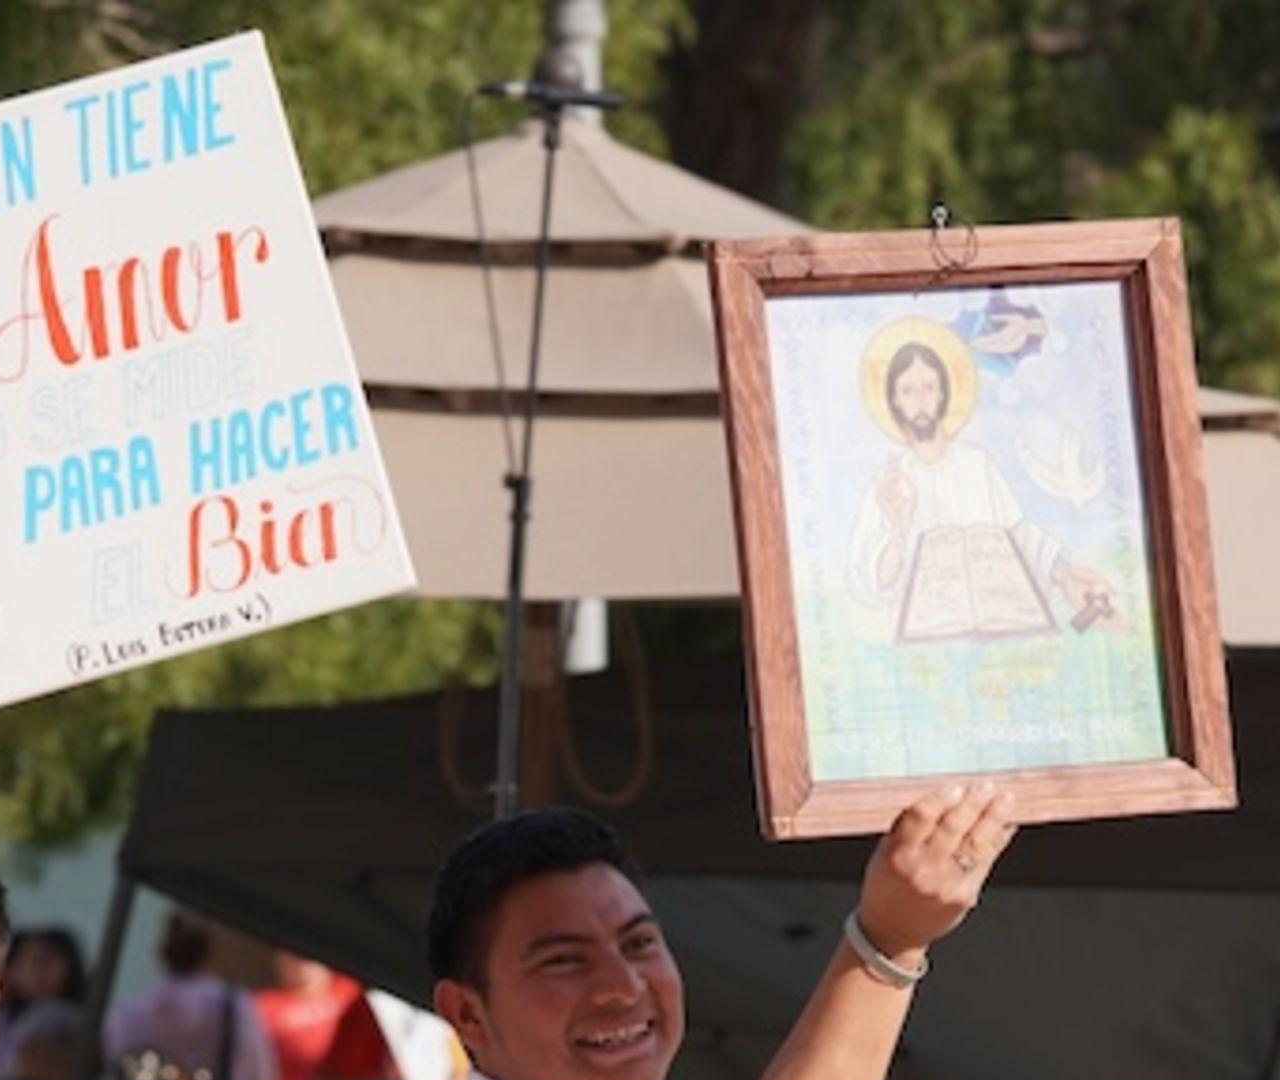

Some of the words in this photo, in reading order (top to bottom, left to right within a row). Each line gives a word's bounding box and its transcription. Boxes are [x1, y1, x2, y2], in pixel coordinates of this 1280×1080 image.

[64, 59, 236, 186] TIENE
[31, 372, 96, 449] SE
[122, 327, 255, 428] MIDE
[23, 434, 161, 543] PARA
[189, 381, 359, 496] HACER
[91, 538, 158, 626] EL
